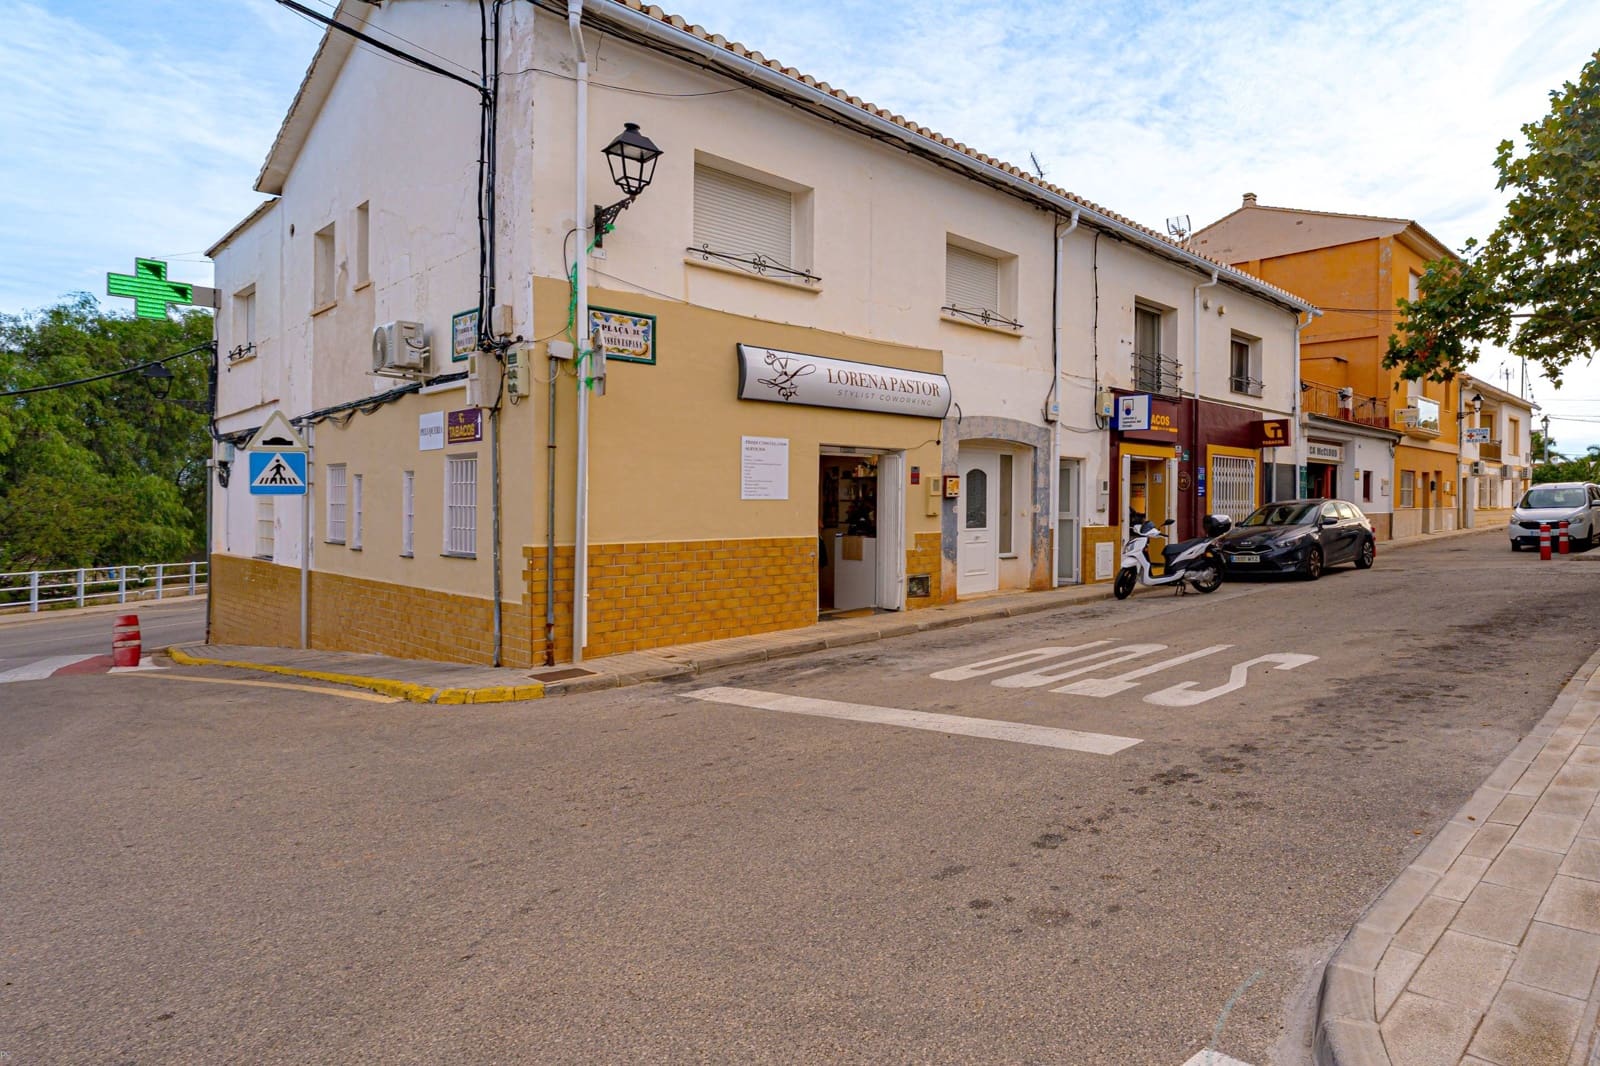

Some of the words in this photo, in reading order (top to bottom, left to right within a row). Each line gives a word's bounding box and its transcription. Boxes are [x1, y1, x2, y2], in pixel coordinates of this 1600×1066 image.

[601, 324, 629, 335] PLAÇA
[826, 368, 888, 391] LORENA
[890, 376, 941, 398] PASTOR
[837, 389, 875, 400] STYLIST
[879, 394, 932, 407] COWORKING
[1151, 414, 1170, 426] ACOS
[449, 423, 475, 437] TABACOS
[928, 637, 1320, 707] STOP
